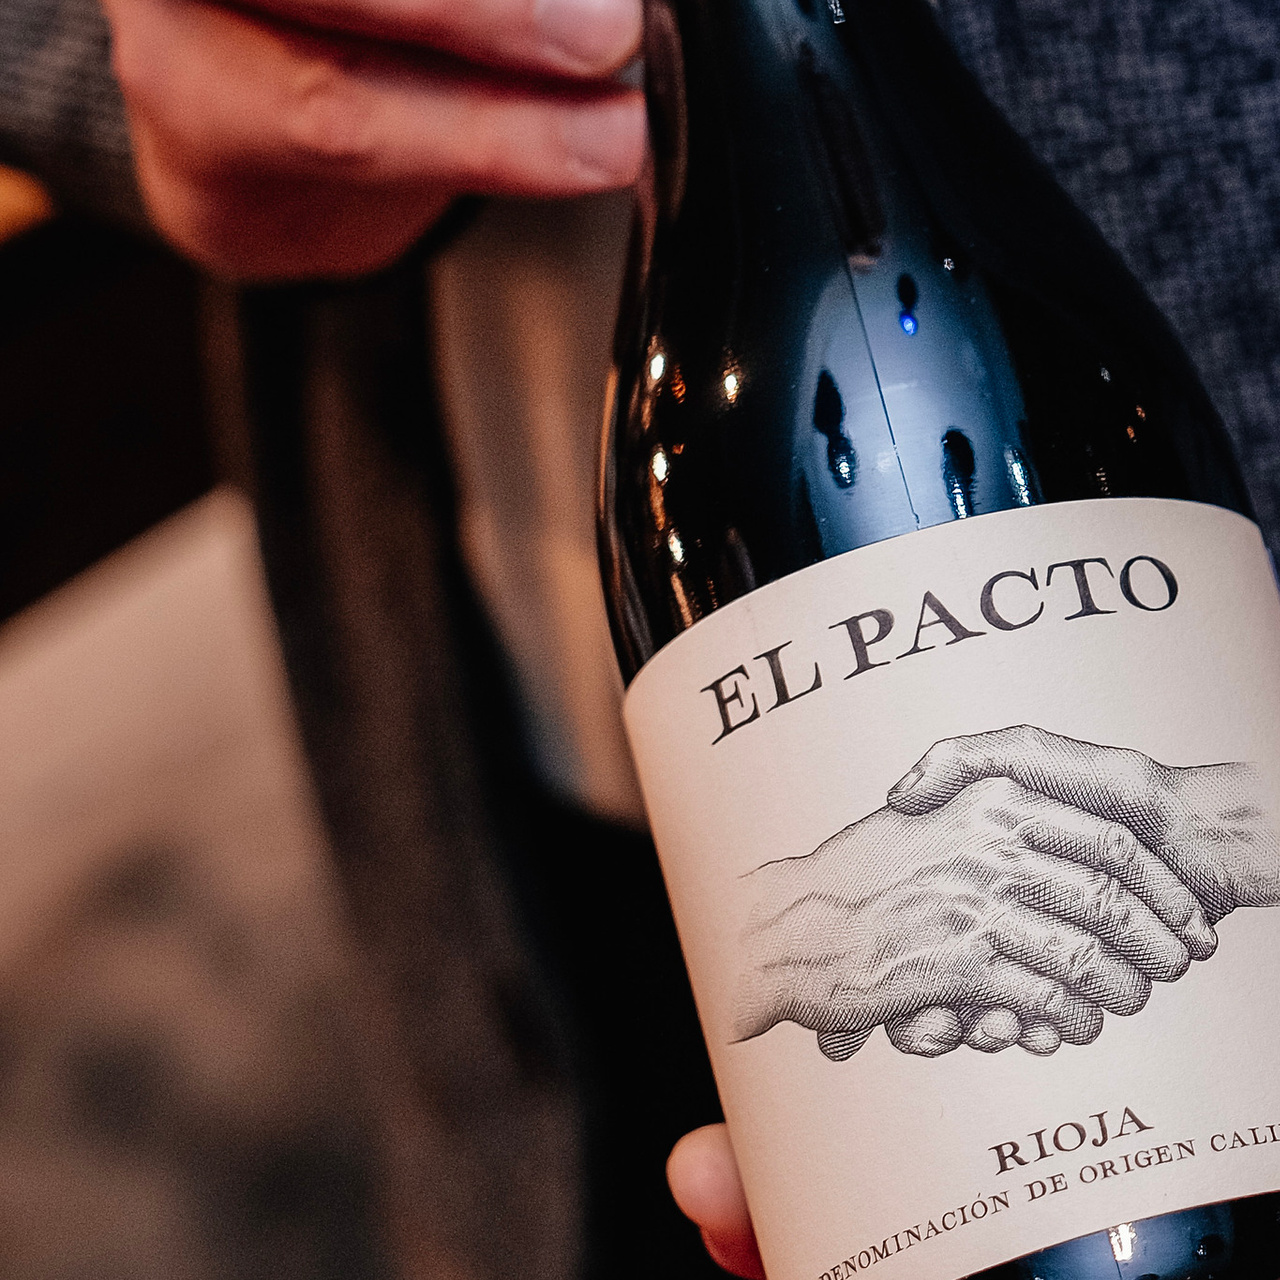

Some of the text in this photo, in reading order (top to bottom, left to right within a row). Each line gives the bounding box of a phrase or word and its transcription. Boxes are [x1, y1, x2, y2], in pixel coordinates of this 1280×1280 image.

[700, 555, 1179, 746] EL PACTO
[987, 1105, 1155, 1176] RIOJA
[1023, 1172, 1069, 1202] DE
[1078, 1138, 1196, 1184] ORIGEN
